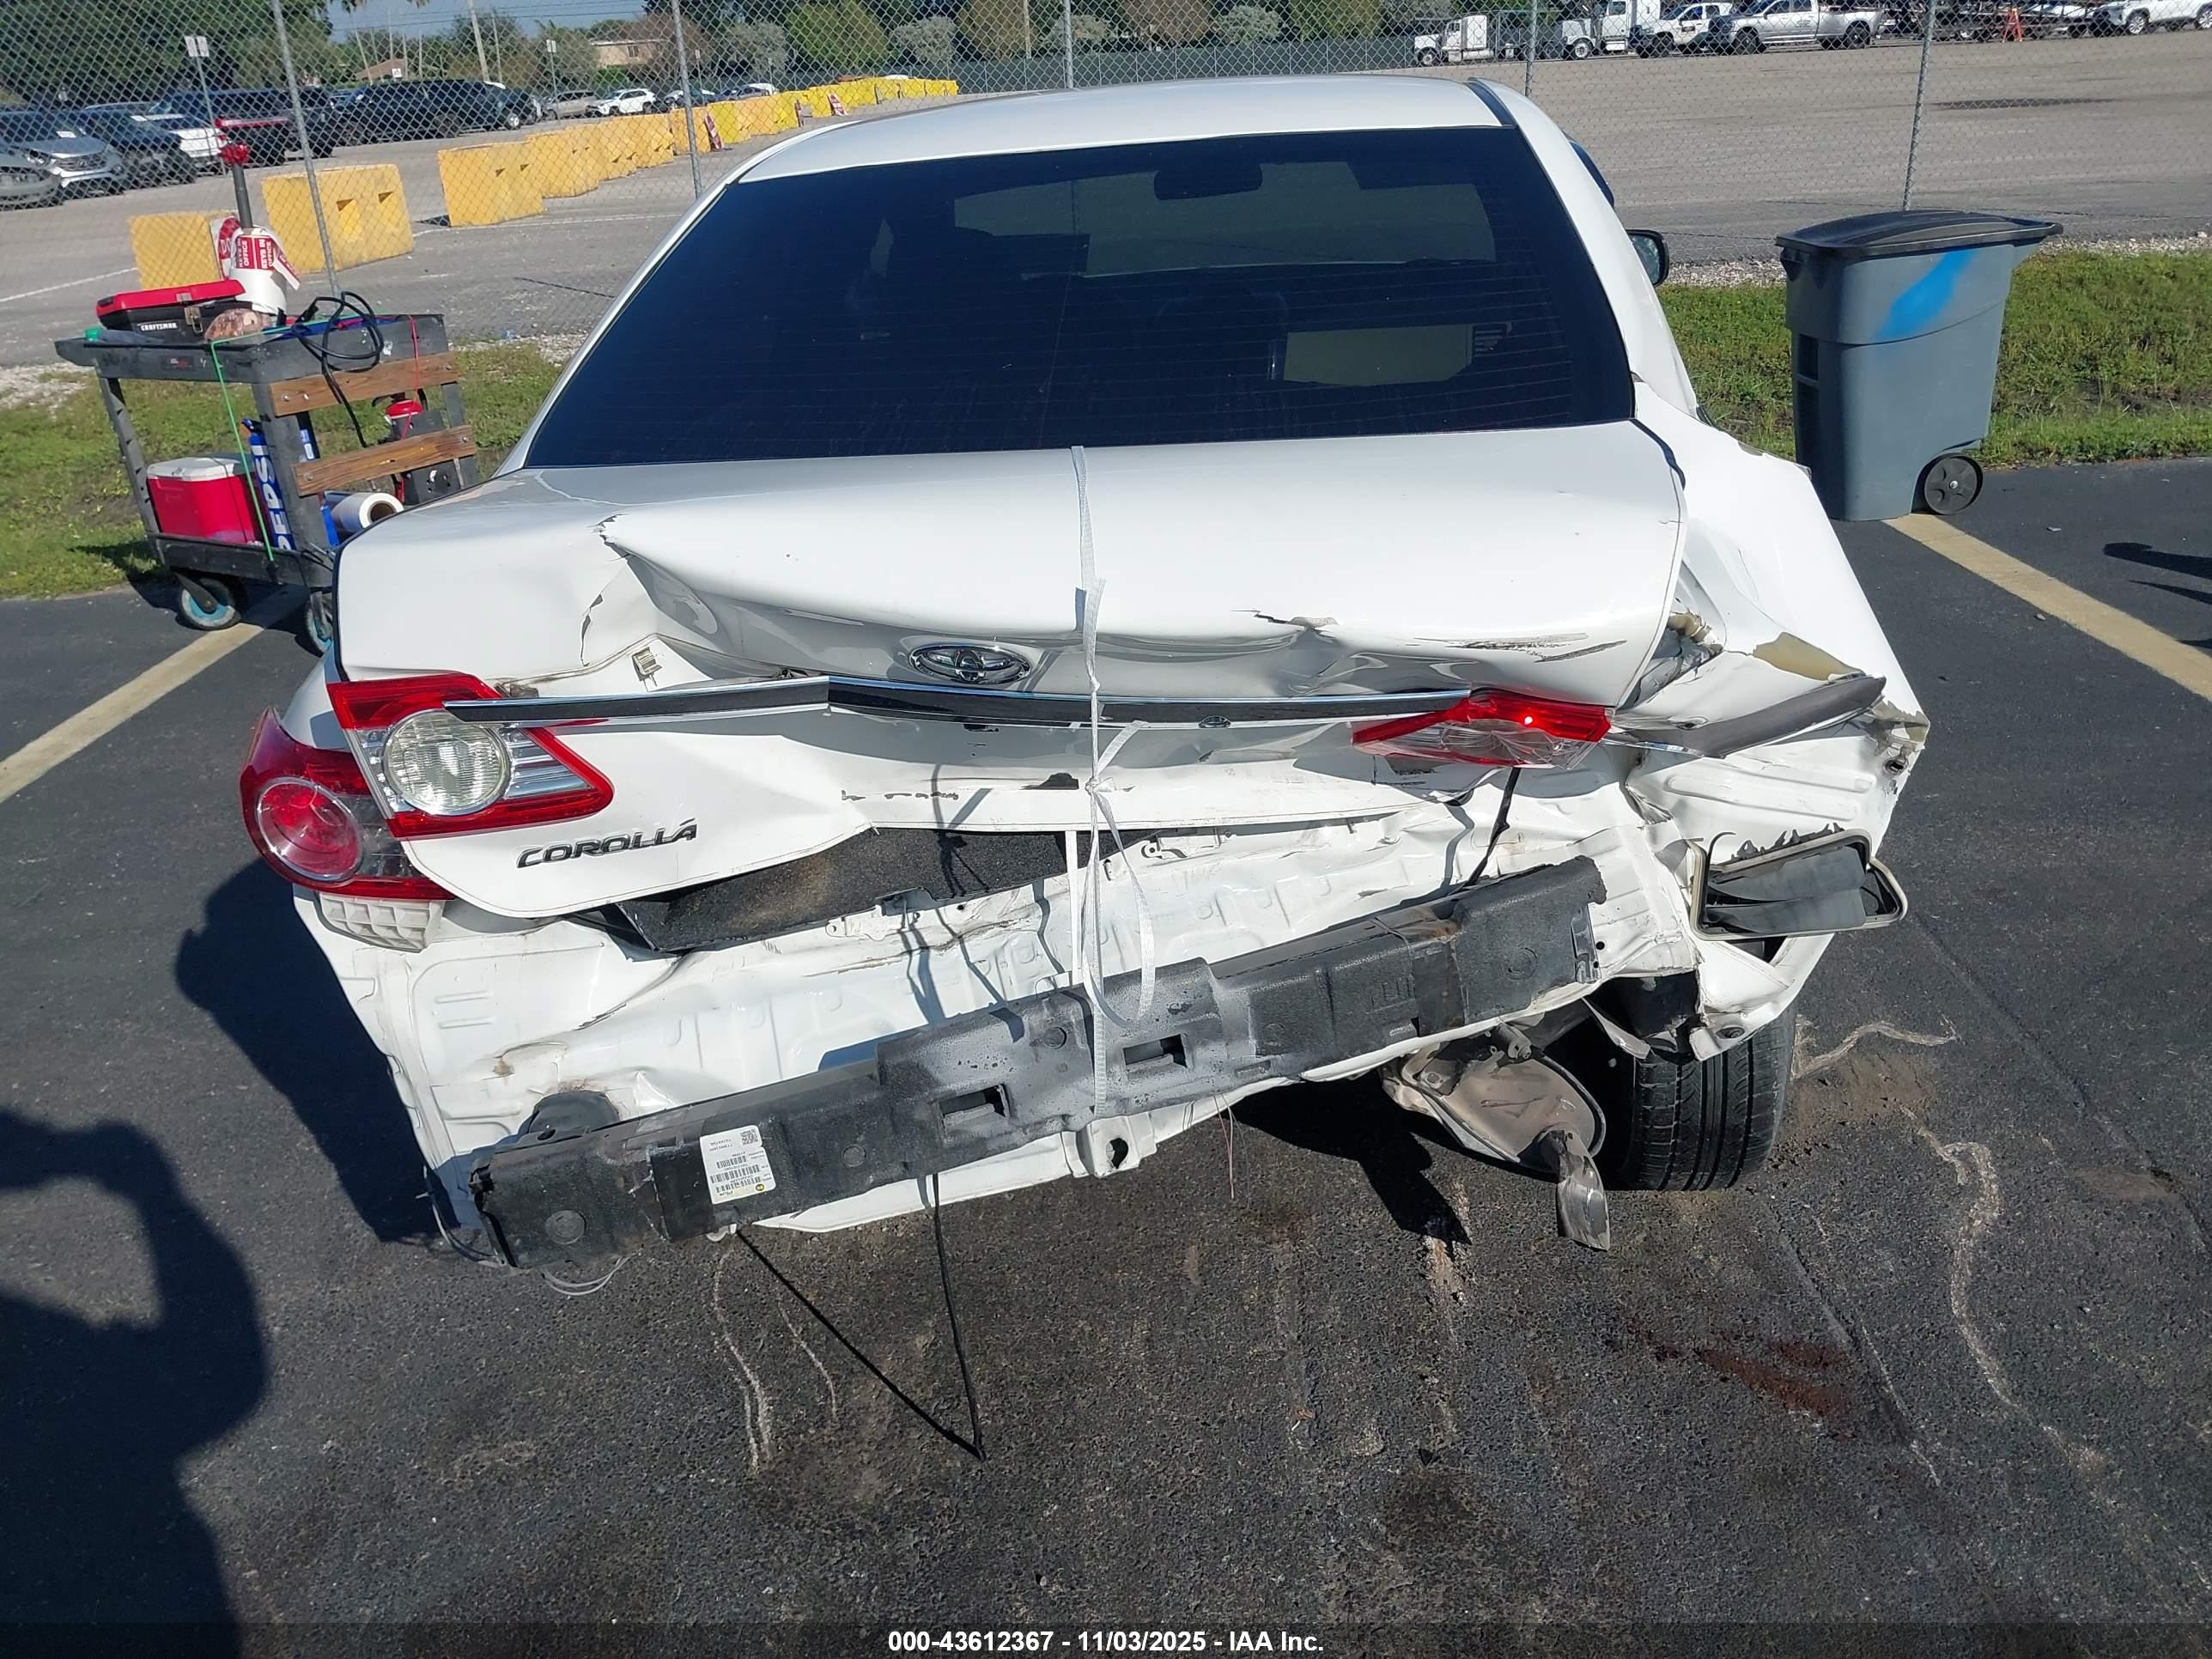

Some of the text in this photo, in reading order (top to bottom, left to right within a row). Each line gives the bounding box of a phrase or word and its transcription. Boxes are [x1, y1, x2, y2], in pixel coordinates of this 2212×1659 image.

[259, 240, 266, 248] IN
[241, 240, 250, 266] OFFICE
[141, 322, 178, 331] CRAFTSMAN
[516, 821, 697, 868] COROLLA
